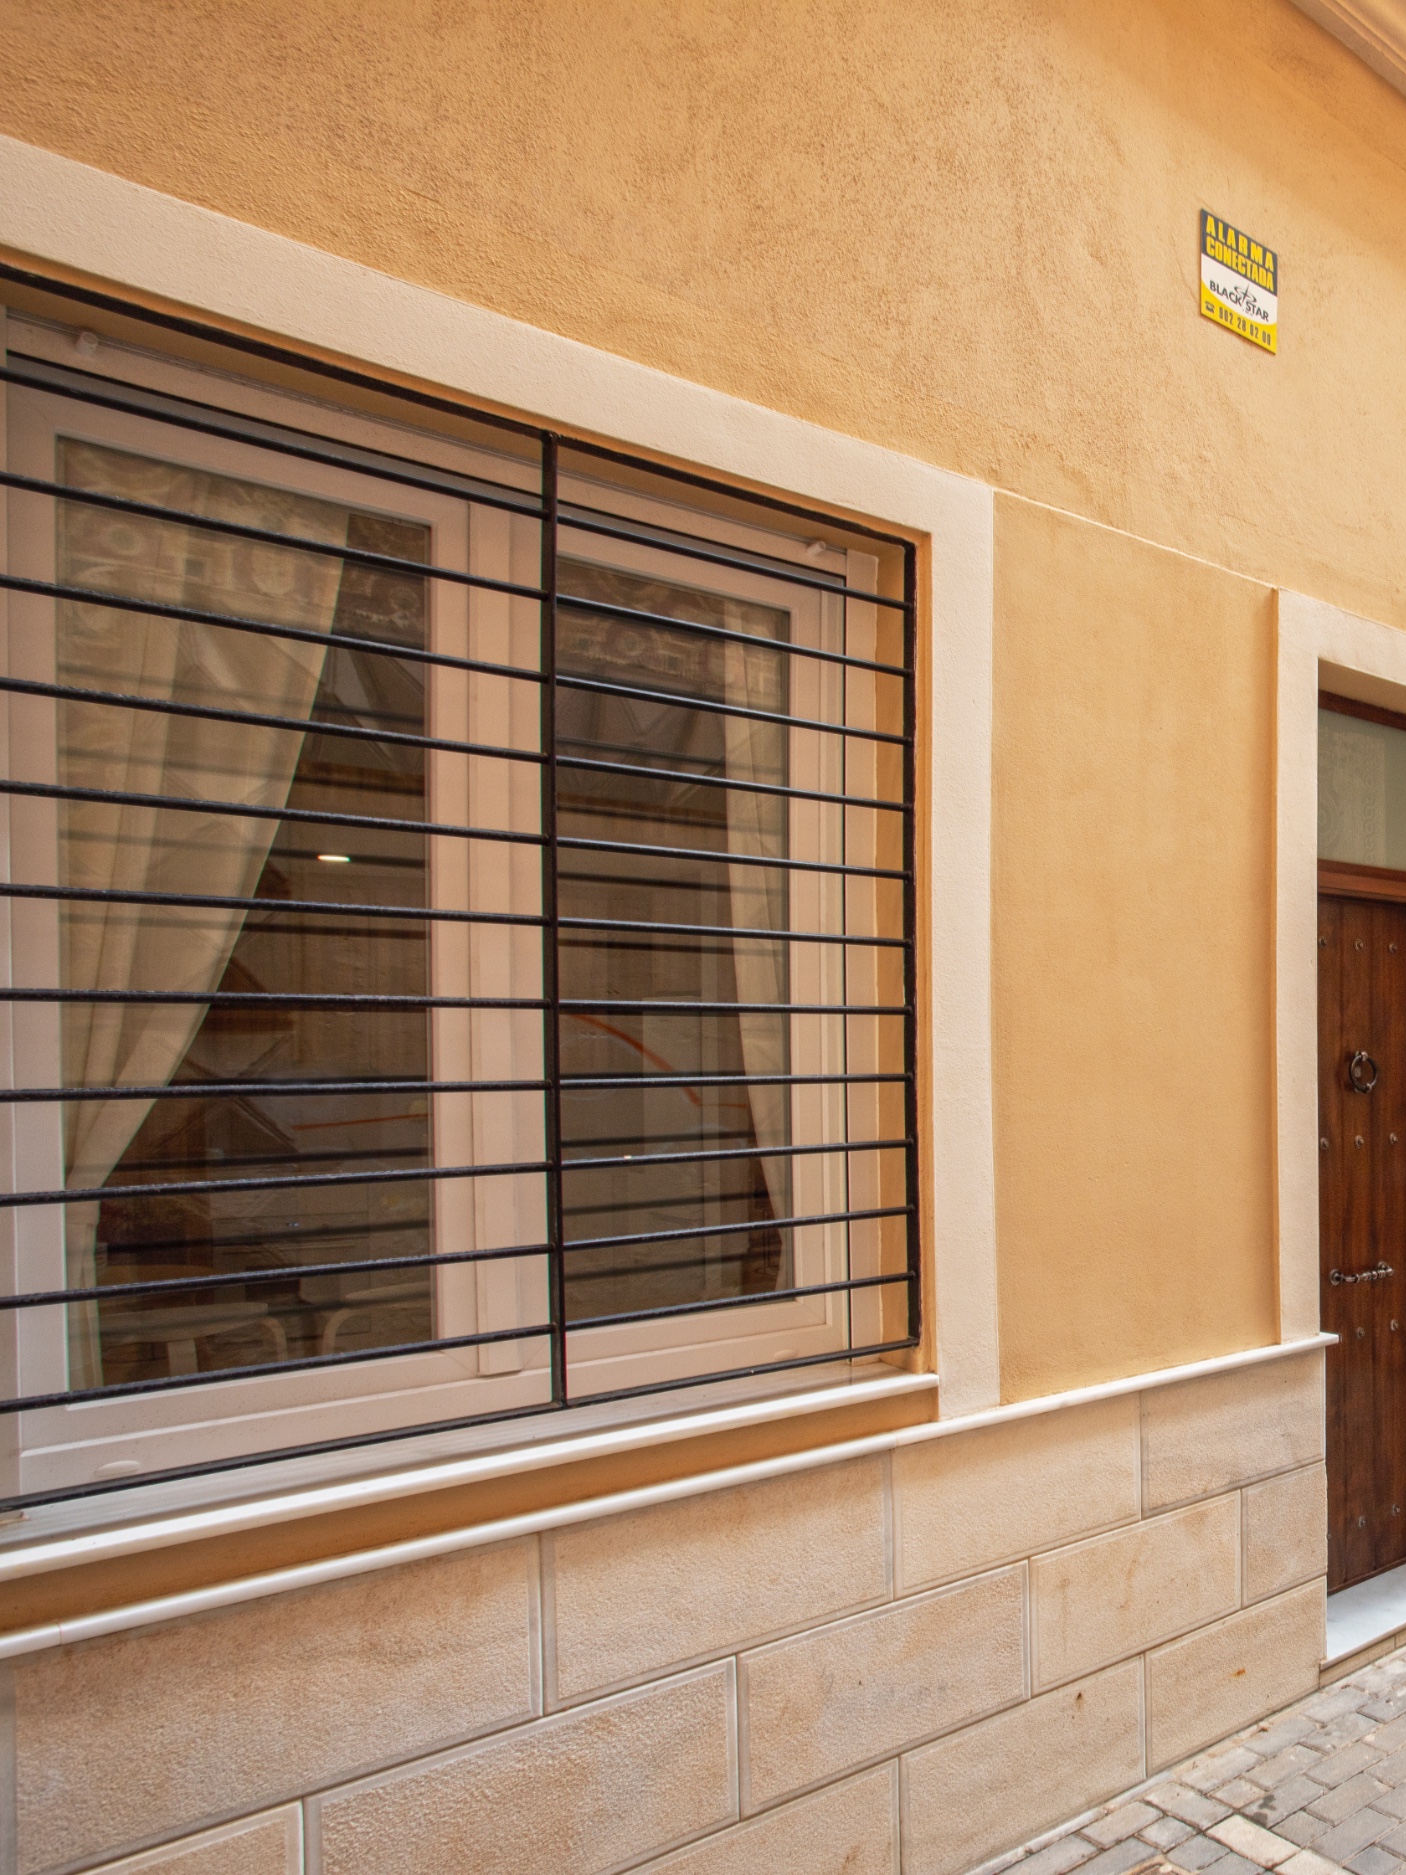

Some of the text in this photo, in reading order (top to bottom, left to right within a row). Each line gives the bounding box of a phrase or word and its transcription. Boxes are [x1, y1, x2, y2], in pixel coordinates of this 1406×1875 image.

[1206, 214, 1274, 272] ALARMA
[1206, 235, 1274, 292] CONECTADA
[1209, 280, 1269, 322] BLACK STAR
